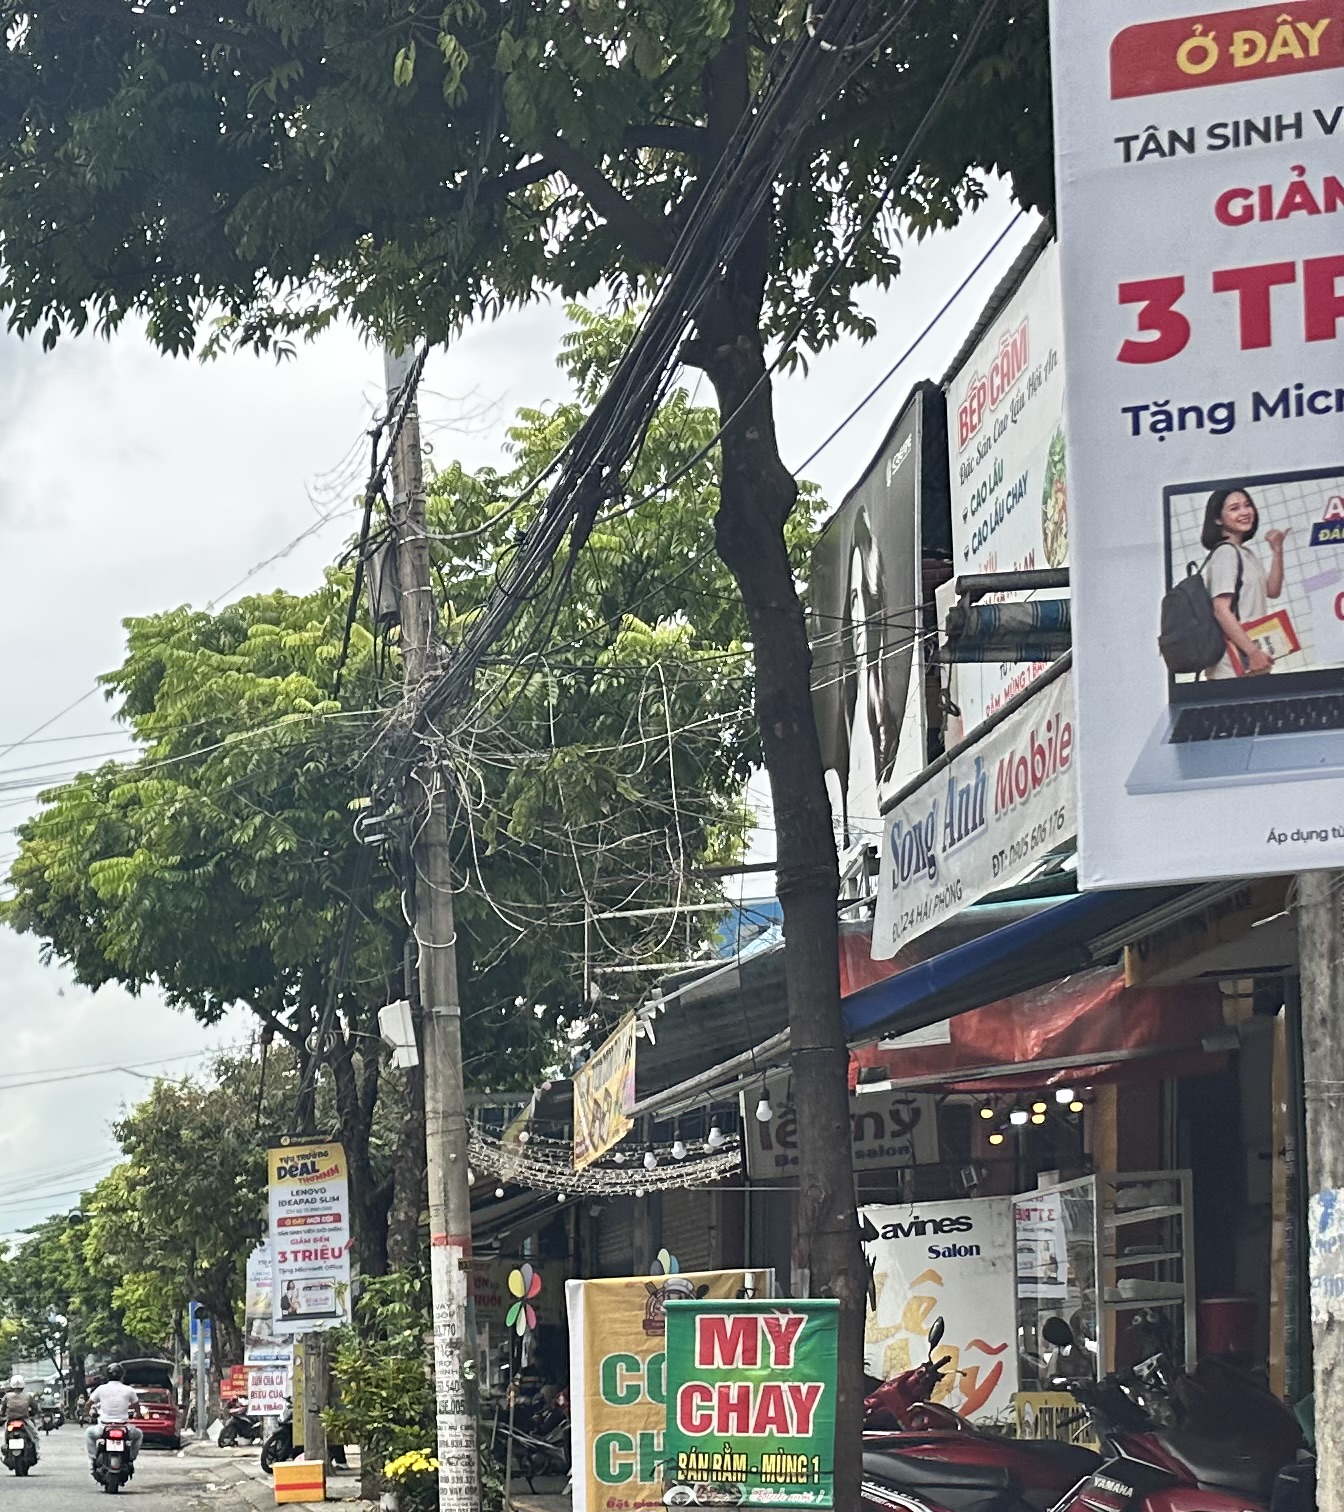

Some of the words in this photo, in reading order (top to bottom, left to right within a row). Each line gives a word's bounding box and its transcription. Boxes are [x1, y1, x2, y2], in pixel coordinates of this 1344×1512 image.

[1176, 24, 1220, 75] Ở
[1229, 13, 1332, 68] ĐÂY
[1114, 125, 1197, 163] TÂN
[1206, 112, 1303, 151] SINH
[1116, 275, 1192, 365] 3
[994, 413, 1008, 444] Cao
[1121, 399, 1236, 442] Tặng
[970, 482, 988, 516] CAO
[972, 520, 989, 555] CAO
[1006, 470, 1029, 516] CHAY
[942, 757, 987, 850] Anh
[994, 713, 1071, 815] Mobile
[1267, 828, 1287, 844] Áp
[1290, 827, 1328, 844] dụng
[278, 1198, 317, 1207] IDEAPAD
[320, 1196, 339, 1204] SLIM
[291, 1188, 326, 1197] LENOVO
[278, 1251, 287, 1264] 3
[290, 1244, 342, 1264] TRIỆU
[927, 1243, 981, 1260] Salon
[677, 1381, 825, 1437] CHAY
[678, 1446, 709, 1482] BÁN
[711, 1442, 747, 1482] RẰM
[761, 1447, 808, 1484] MÙNG
[811, 1454, 820, 1484] 1
[1093, 1477, 1134, 1497] YAMAHA
